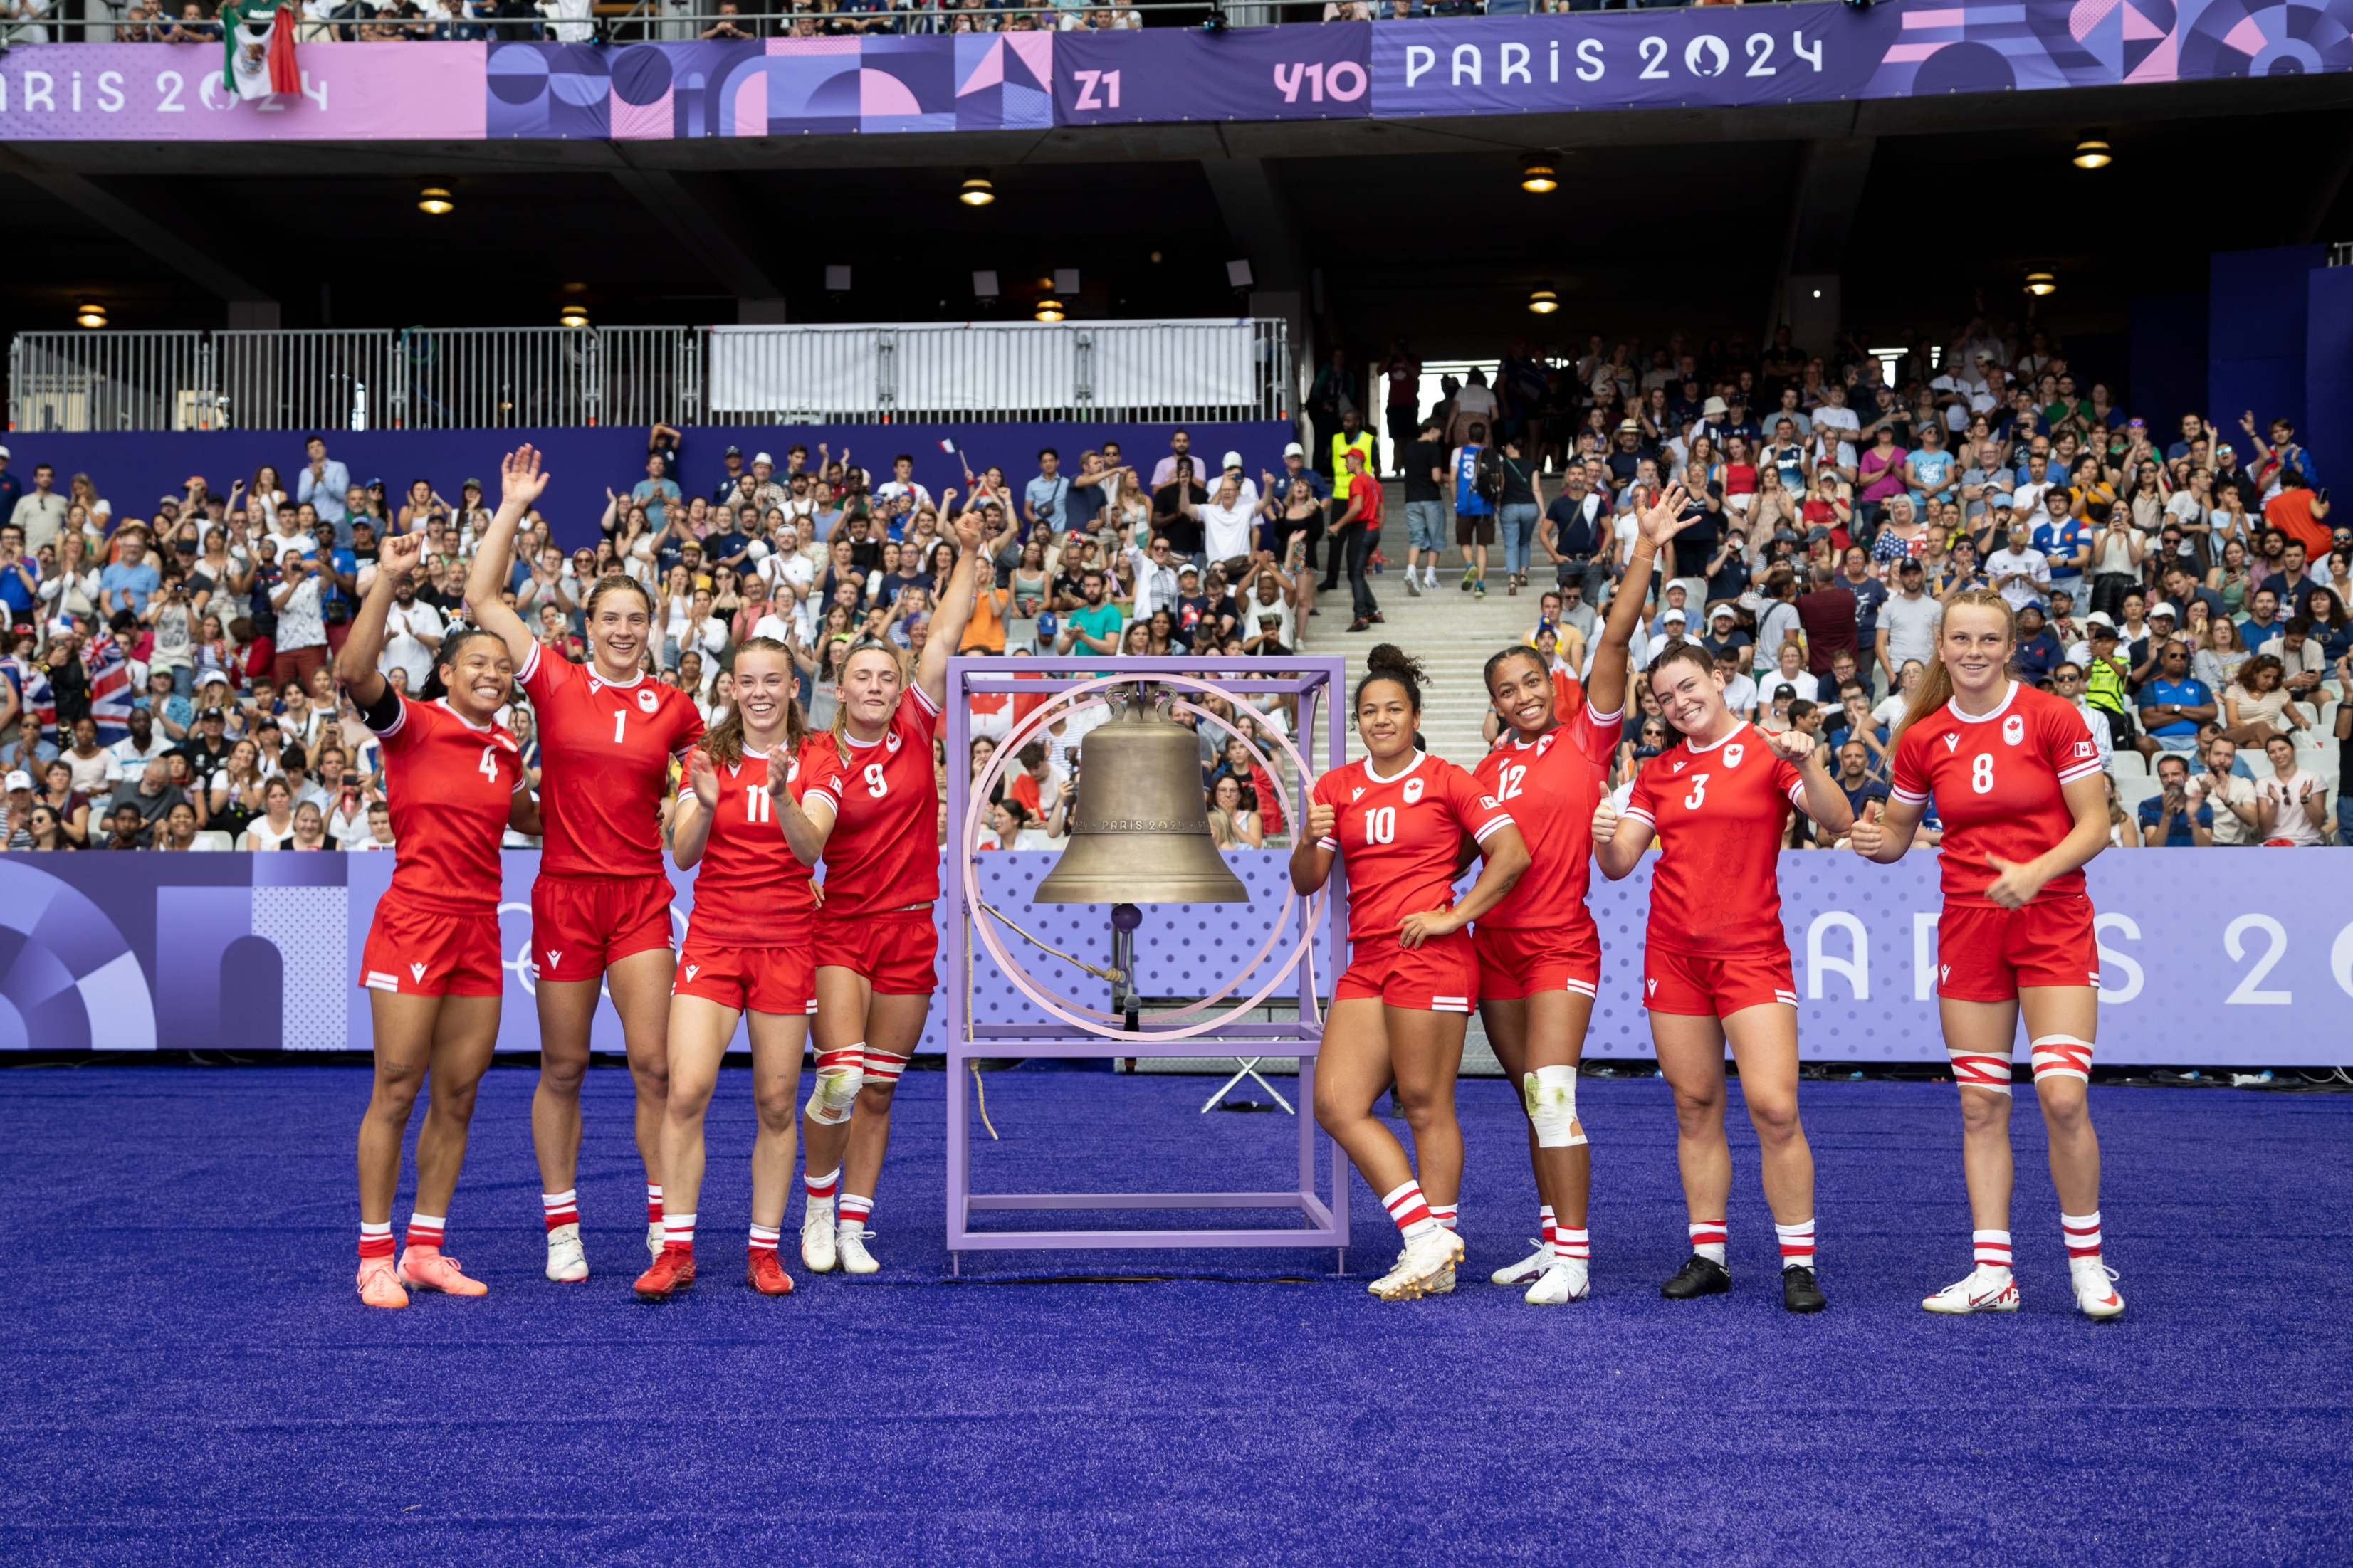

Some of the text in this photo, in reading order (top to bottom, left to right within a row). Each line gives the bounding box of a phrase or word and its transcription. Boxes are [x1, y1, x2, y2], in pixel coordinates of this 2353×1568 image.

[1637, 31, 1823, 80] 2024
[1074, 69, 1121, 111] Z1
[1463, 461, 1475, 480] 3
[614, 709, 627, 743] 1
[478, 744, 498, 783] 4
[864, 763, 888, 798] 9
[1972, 753, 1993, 794] 8
[1497, 764, 1527, 803] 12
[1684, 774, 1709, 810] 3
[746, 784, 770, 822] 11
[1148, 820, 1185, 831] 2024
[1365, 806, 1396, 845] 10
